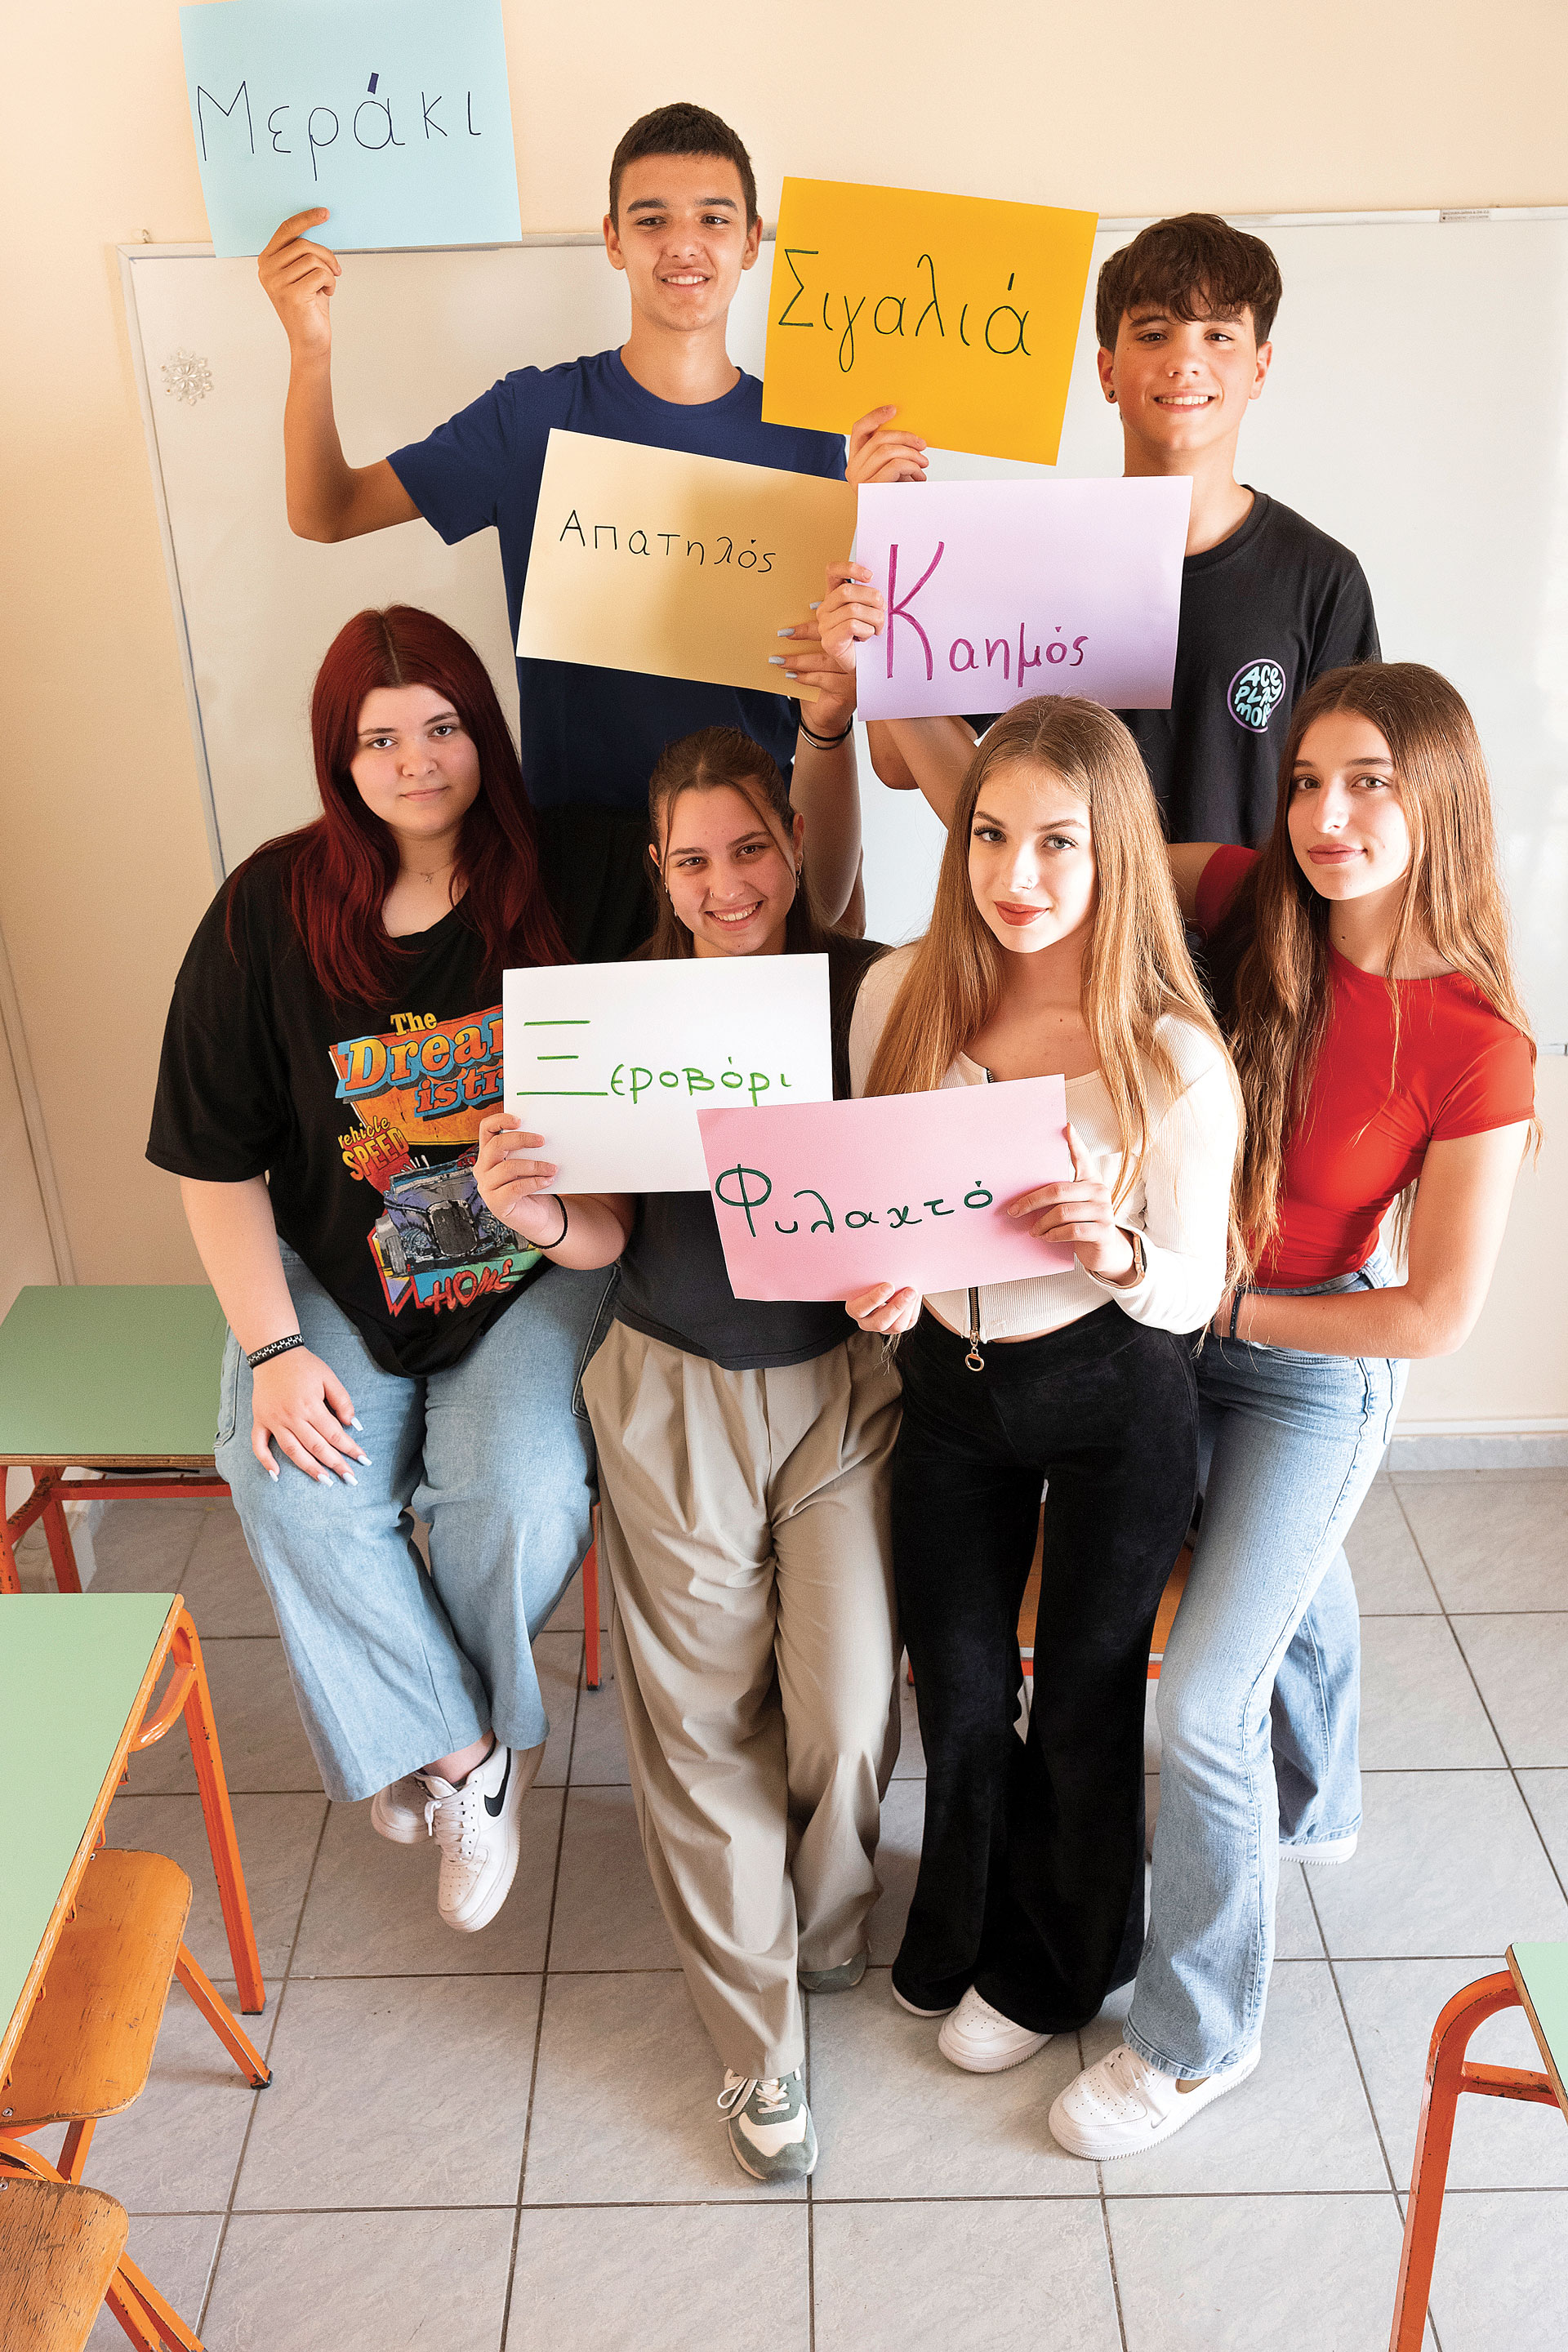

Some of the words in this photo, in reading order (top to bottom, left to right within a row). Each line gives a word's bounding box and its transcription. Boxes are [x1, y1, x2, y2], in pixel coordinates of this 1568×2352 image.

[197, 72, 482, 181] Μεράκι
[778, 248, 1031, 373] Σιγαλιά
[559, 510, 777, 573] Απατηλός
[886, 541, 1089, 688] Καημός
[390, 1012, 438, 1037] The
[516, 1020, 793, 1107] Ξεροβόρι
[341, 1127, 410, 1181] SPEED
[715, 1164, 994, 1237] Φυλαχτό
[423, 1258, 513, 1316] HOME
